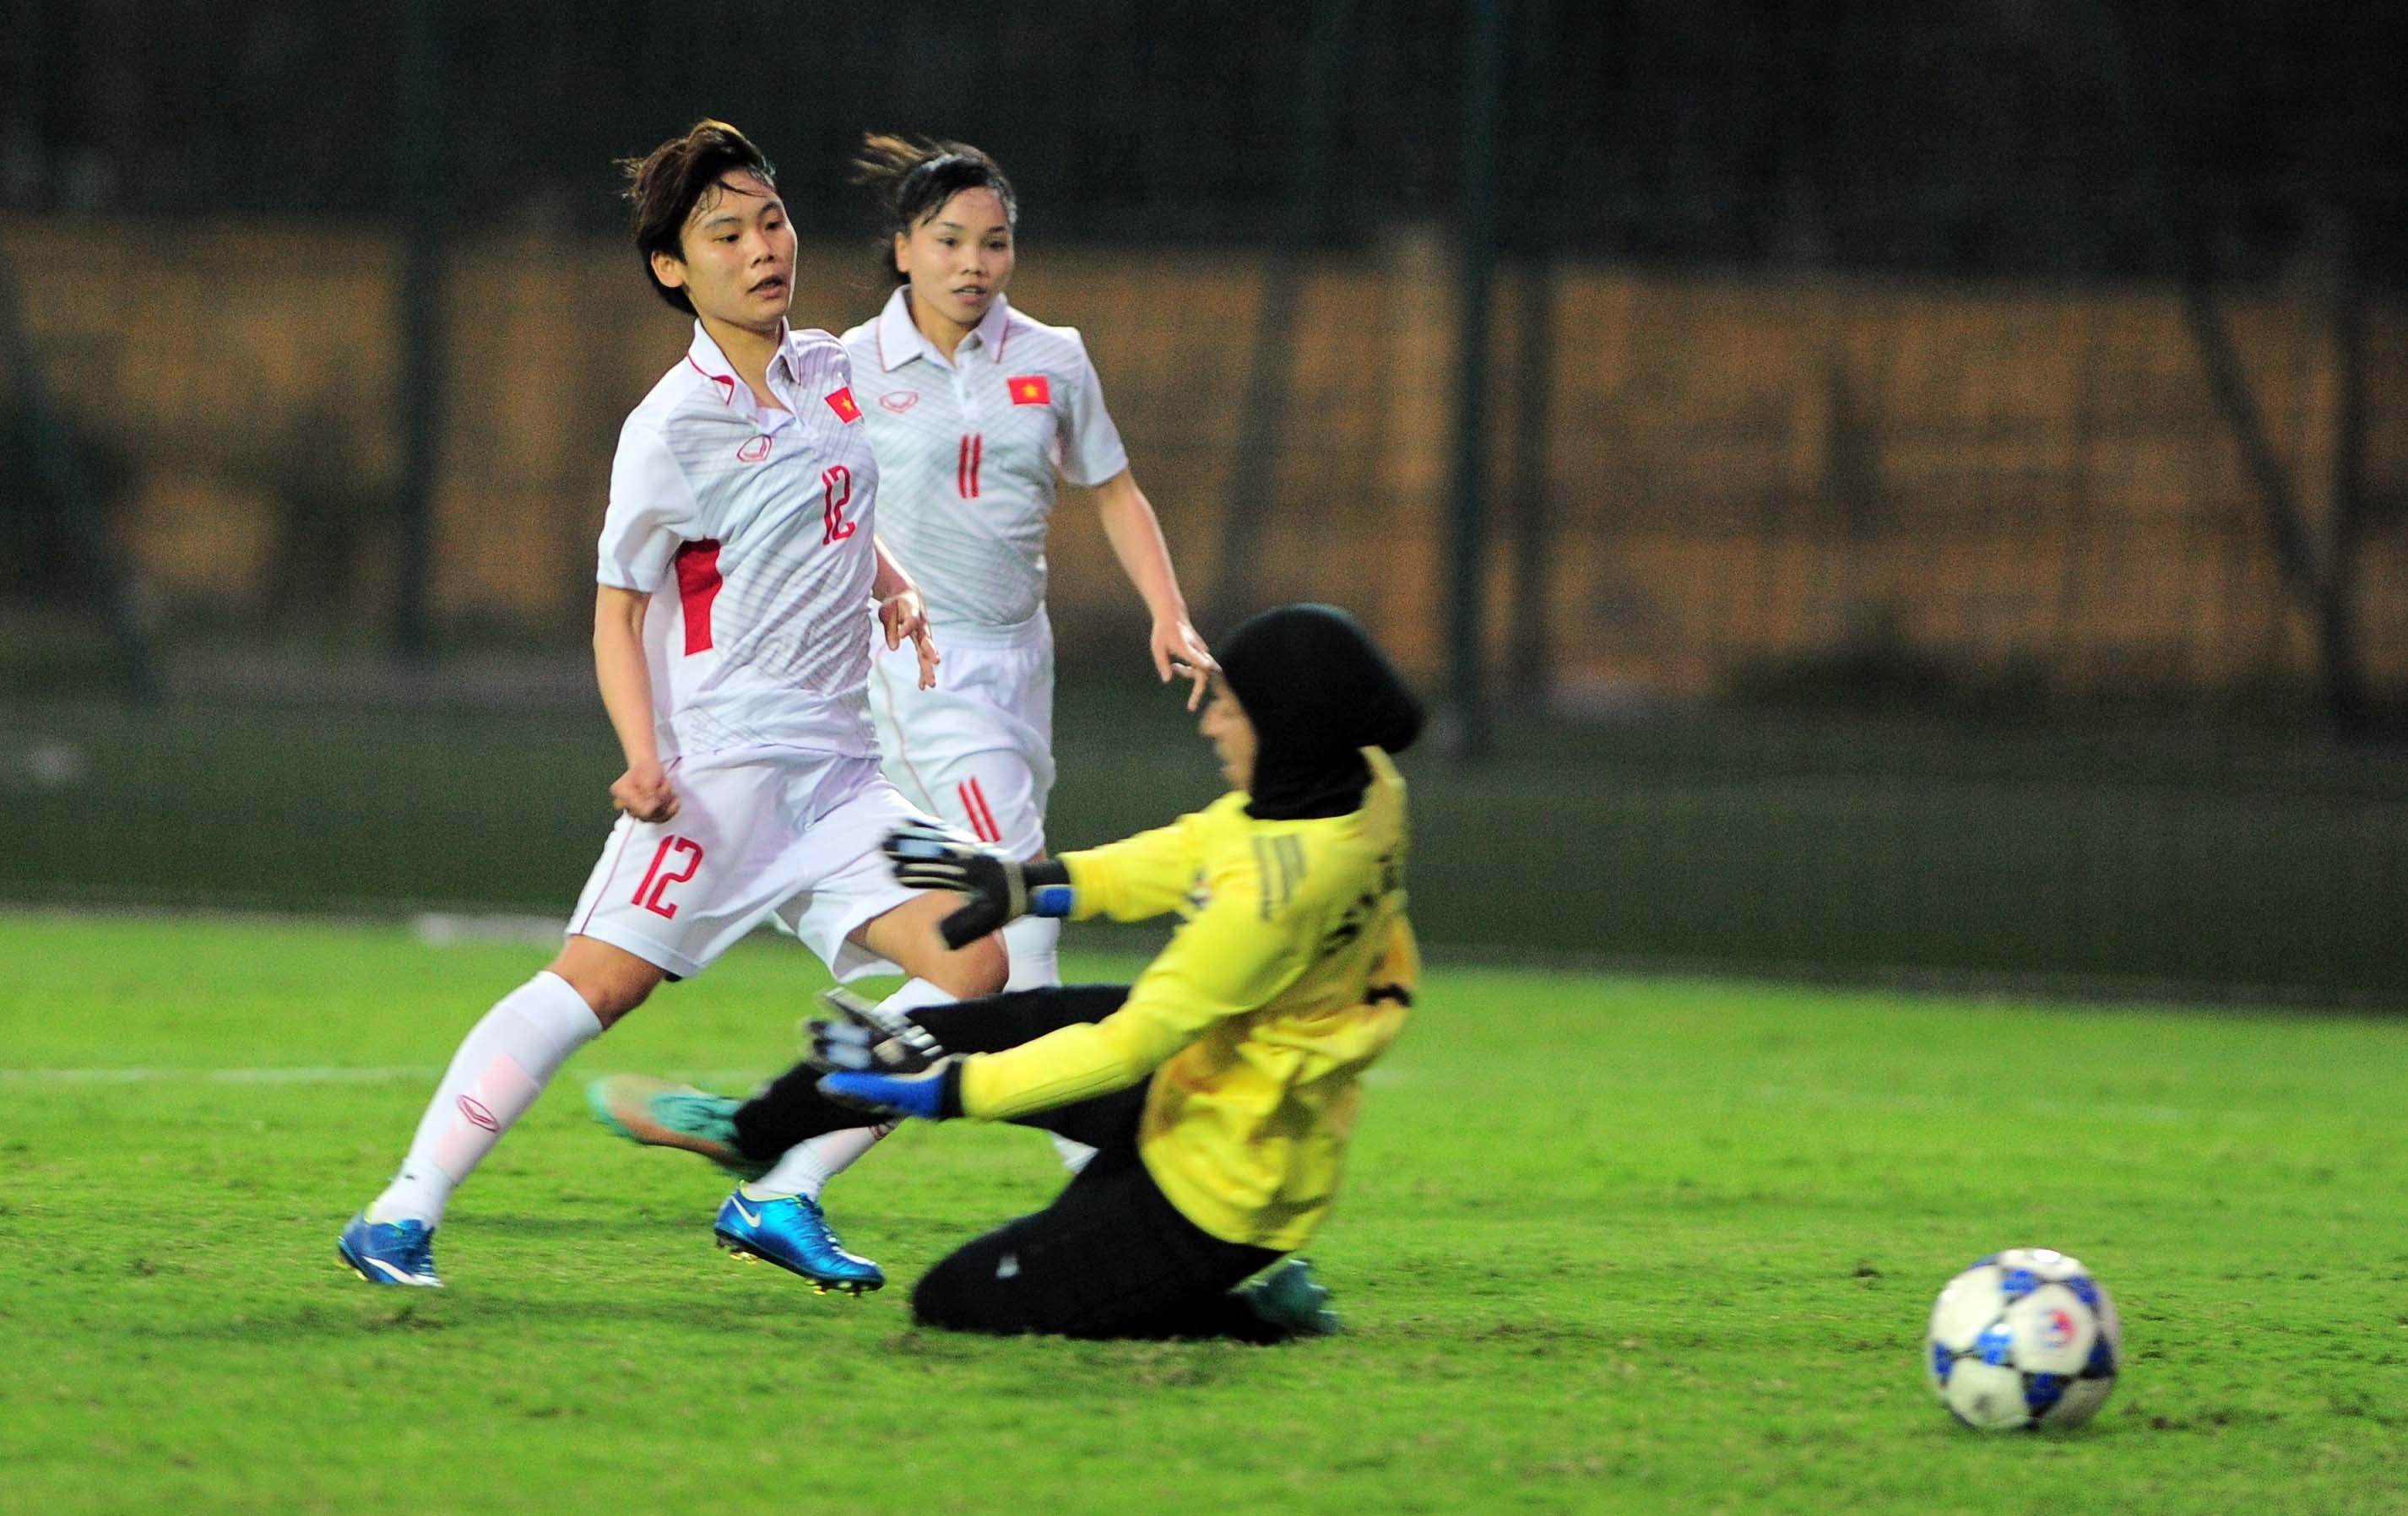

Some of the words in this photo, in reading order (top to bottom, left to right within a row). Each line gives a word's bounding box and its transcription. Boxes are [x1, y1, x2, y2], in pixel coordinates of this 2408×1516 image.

[957, 434, 982, 499] 11
[821, 464, 857, 546] 12
[957, 775, 1001, 842] 11
[631, 834, 704, 920] 12
